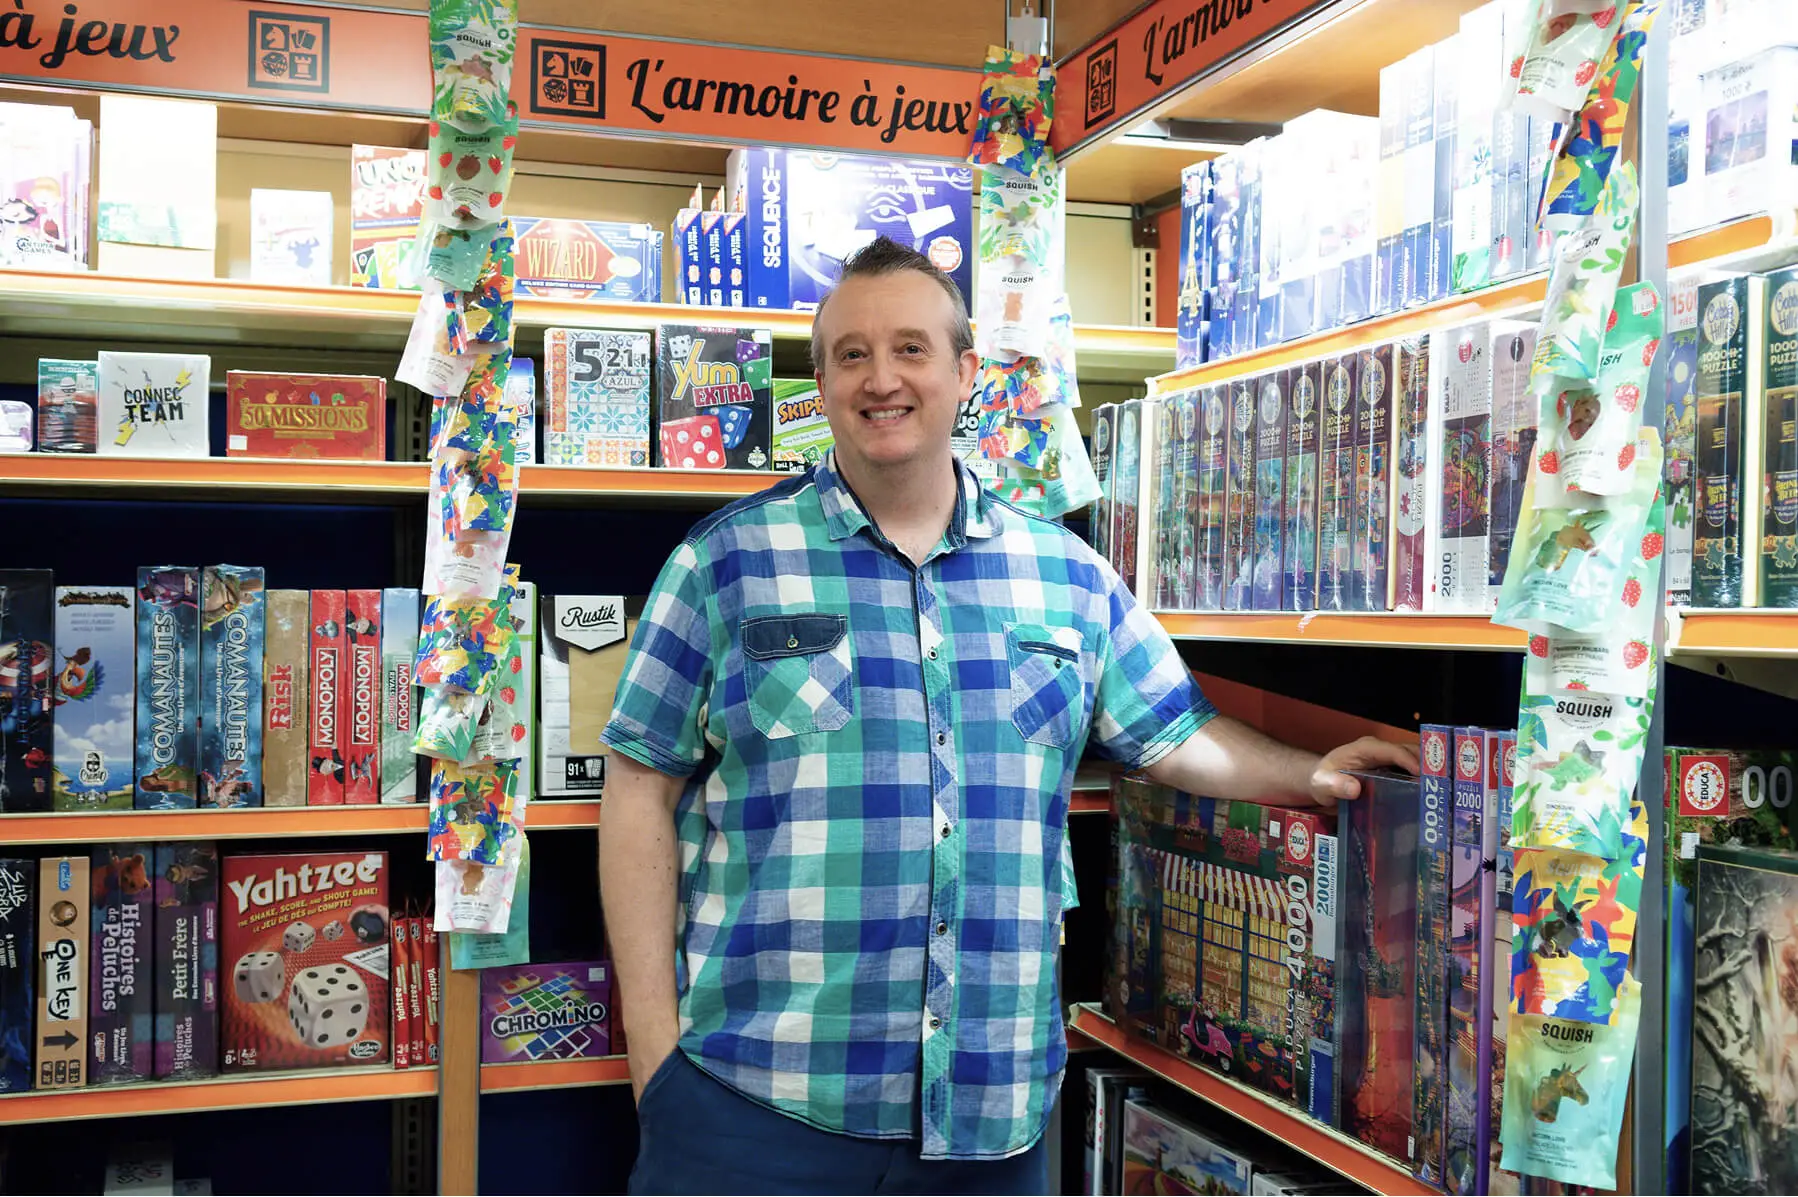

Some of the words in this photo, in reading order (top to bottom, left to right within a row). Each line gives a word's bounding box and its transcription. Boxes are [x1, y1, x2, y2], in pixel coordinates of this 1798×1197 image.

[0, 0, 42, 49] à
[39, 3, 180, 69] jeux
[626, 59, 840, 124] L'armoire
[850, 79, 882, 126] à
[880, 85, 973, 144] jeux
[357, 153, 424, 186] UNO
[1006, 181, 1040, 192] SQUISH
[762, 166, 782, 268] SEQUENCE
[526, 238, 598, 281] WIZARD
[1002, 275, 1035, 285] SQUISH
[670, 338, 740, 401] Yum
[1702, 358, 1739, 374] PUZZLE
[1770, 353, 1798, 366] PUZZ
[608, 377, 637, 387] AZUL
[693, 381, 755, 407] EXTRA
[124, 403, 184, 423] TEAM
[244, 406, 267, 427] 50
[270, 406, 364, 430] MISSIONS
[1360, 418, 1385, 431] PUZZLE
[1441, 552, 1453, 597] 2000
[561, 604, 619, 628] Rustik
[1671, 590, 1691, 603] Nath
[152, 612, 177, 765] COMANAUTES
[224, 611, 249, 762] COMANAUTES
[269, 664, 293, 731] Risk
[319, 650, 335, 744] MONOPOLY
[356, 649, 371, 742] MONOPOLY
[398, 665, 409, 731] MONOPOLY
[1556, 700, 1613, 719] SQUISH
[1456, 791, 1481, 810] 2000
[1701, 772, 1709, 800] EDUCA
[1425, 778, 1439, 844] 2000
[228, 860, 378, 914] Yahtzee
[250, 907, 279, 924] SHAKE,
[280, 901, 307, 914] SCORE,
[323, 890, 351, 903] SHOUT
[352, 887, 379, 897] GAME!
[1317, 862, 1330, 916] 2000
[108, 907, 120, 921] de
[261, 919, 277, 931] JEU
[317, 899, 352, 914] COMPTE!
[1287, 875, 1308, 981] 4000
[119, 903, 142, 996] Histoires
[171, 916, 188, 955] Frère
[102, 922, 121, 1012] Peluches
[171, 959, 188, 1000] Petit
[427, 967, 439, 1002] Yahtzee
[394, 986, 406, 1022] Yahtzee
[410, 983, 421, 1019] Yahtzee
[184, 1016, 193, 1060] Peluches
[1285, 988, 1294, 1059] EDUCA
[1296, 991, 1305, 1071] PUZZLE
[1541, 1022, 1594, 1043] SQUISH
[173, 1023, 185, 1070] Histoires
[1308, 1054, 1316, 1112] Ravensburger
